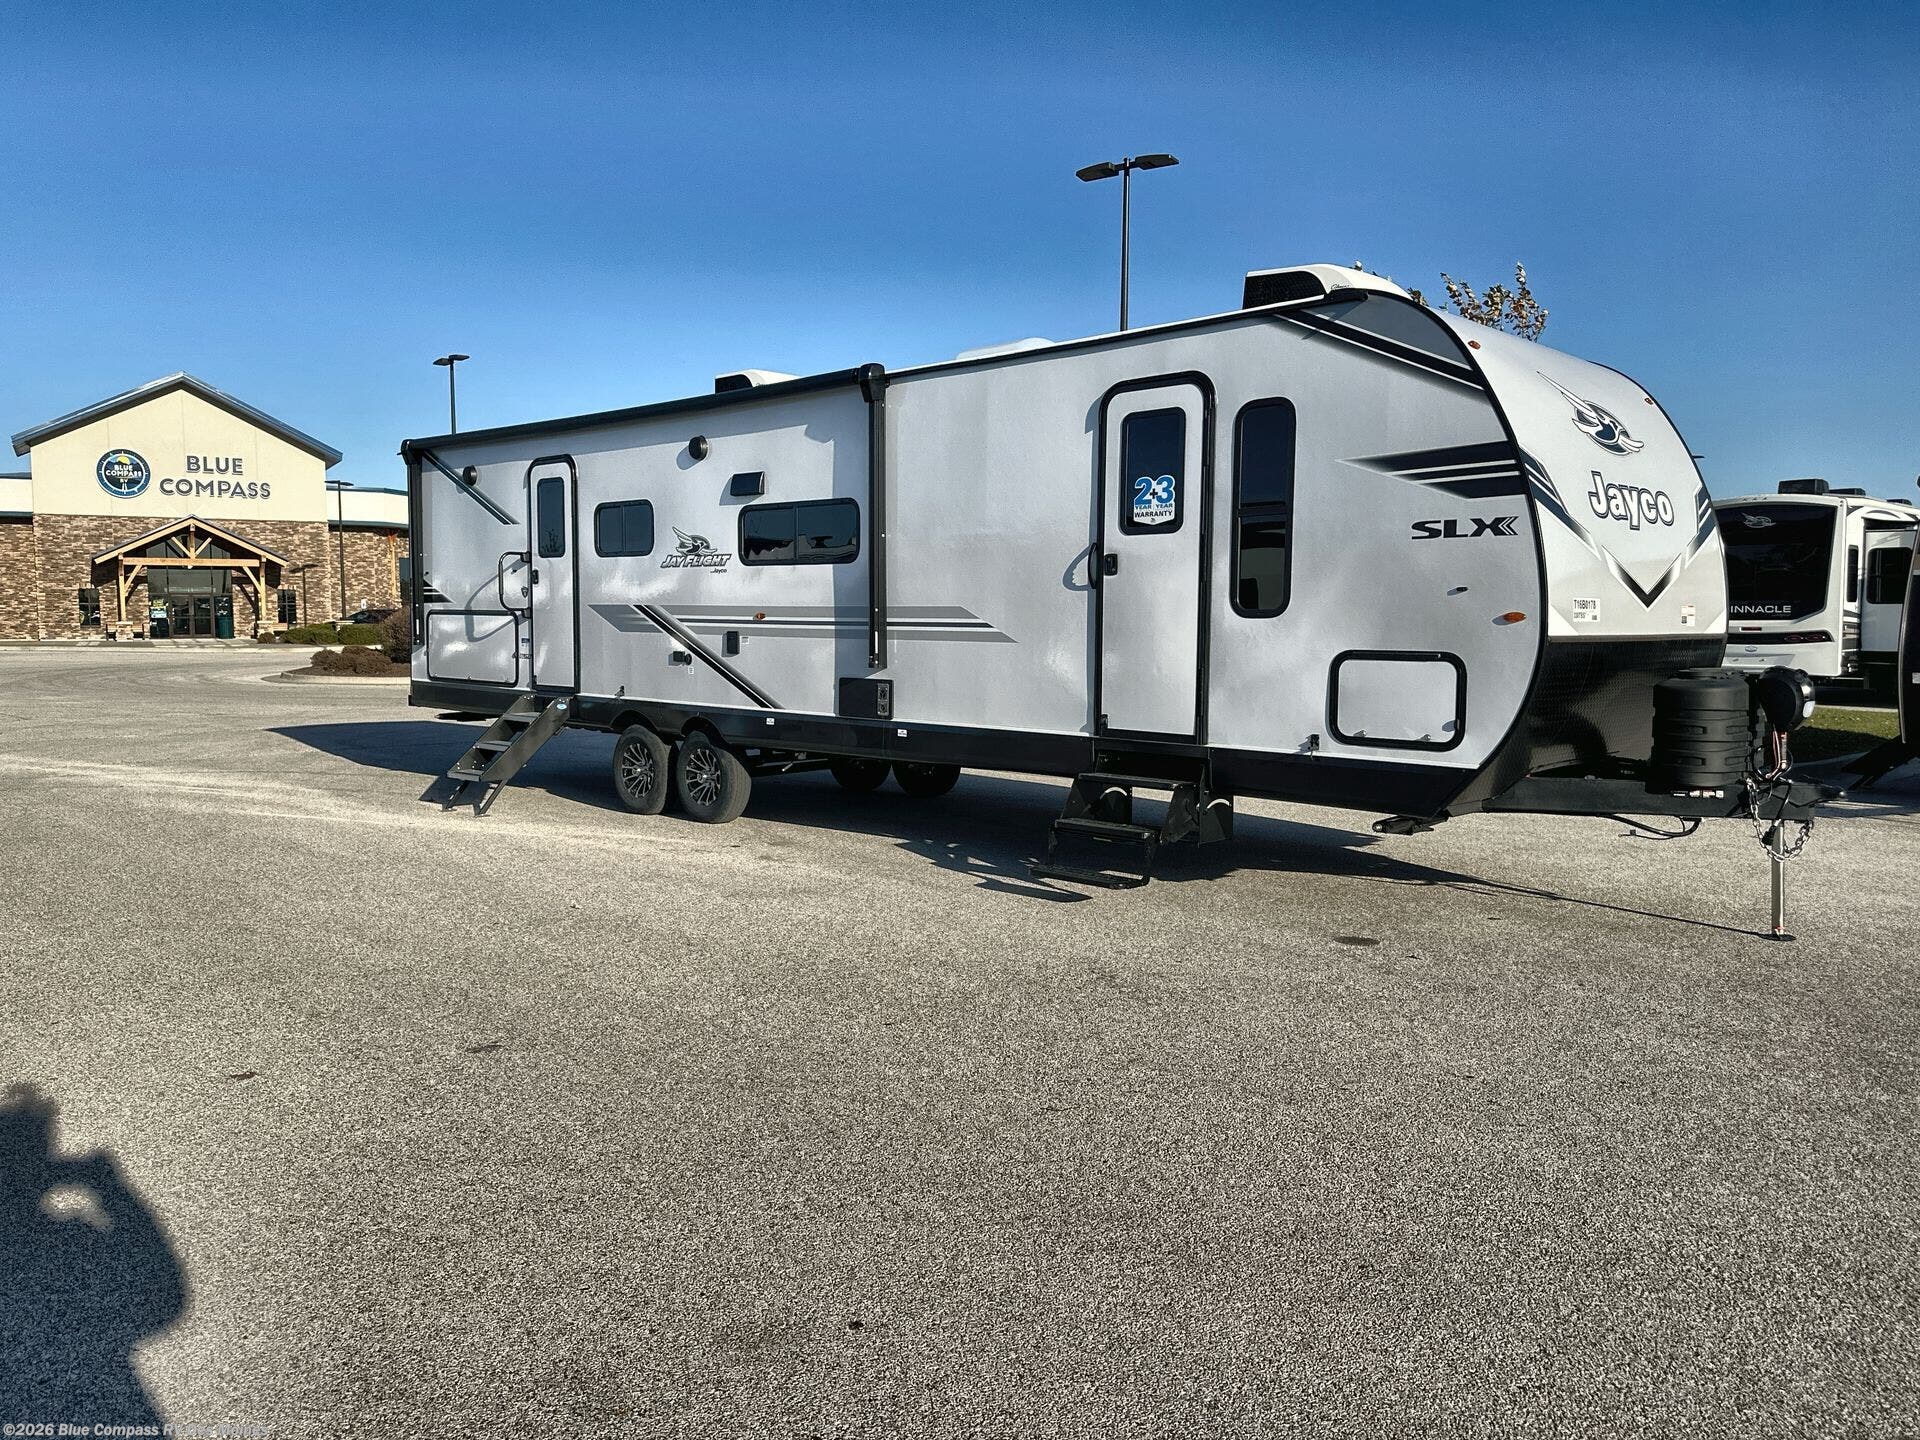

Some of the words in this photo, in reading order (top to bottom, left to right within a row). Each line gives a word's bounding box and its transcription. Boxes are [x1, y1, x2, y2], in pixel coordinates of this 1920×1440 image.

[186, 455, 243, 475] BLUE
[159, 478, 271, 499] COMPASS
[1588, 470, 1675, 531] Jayco
[1134, 510, 1173, 518] WARRANTY
[1411, 516, 1519, 540] SLX
[1730, 605, 1792, 614] INNACLE
